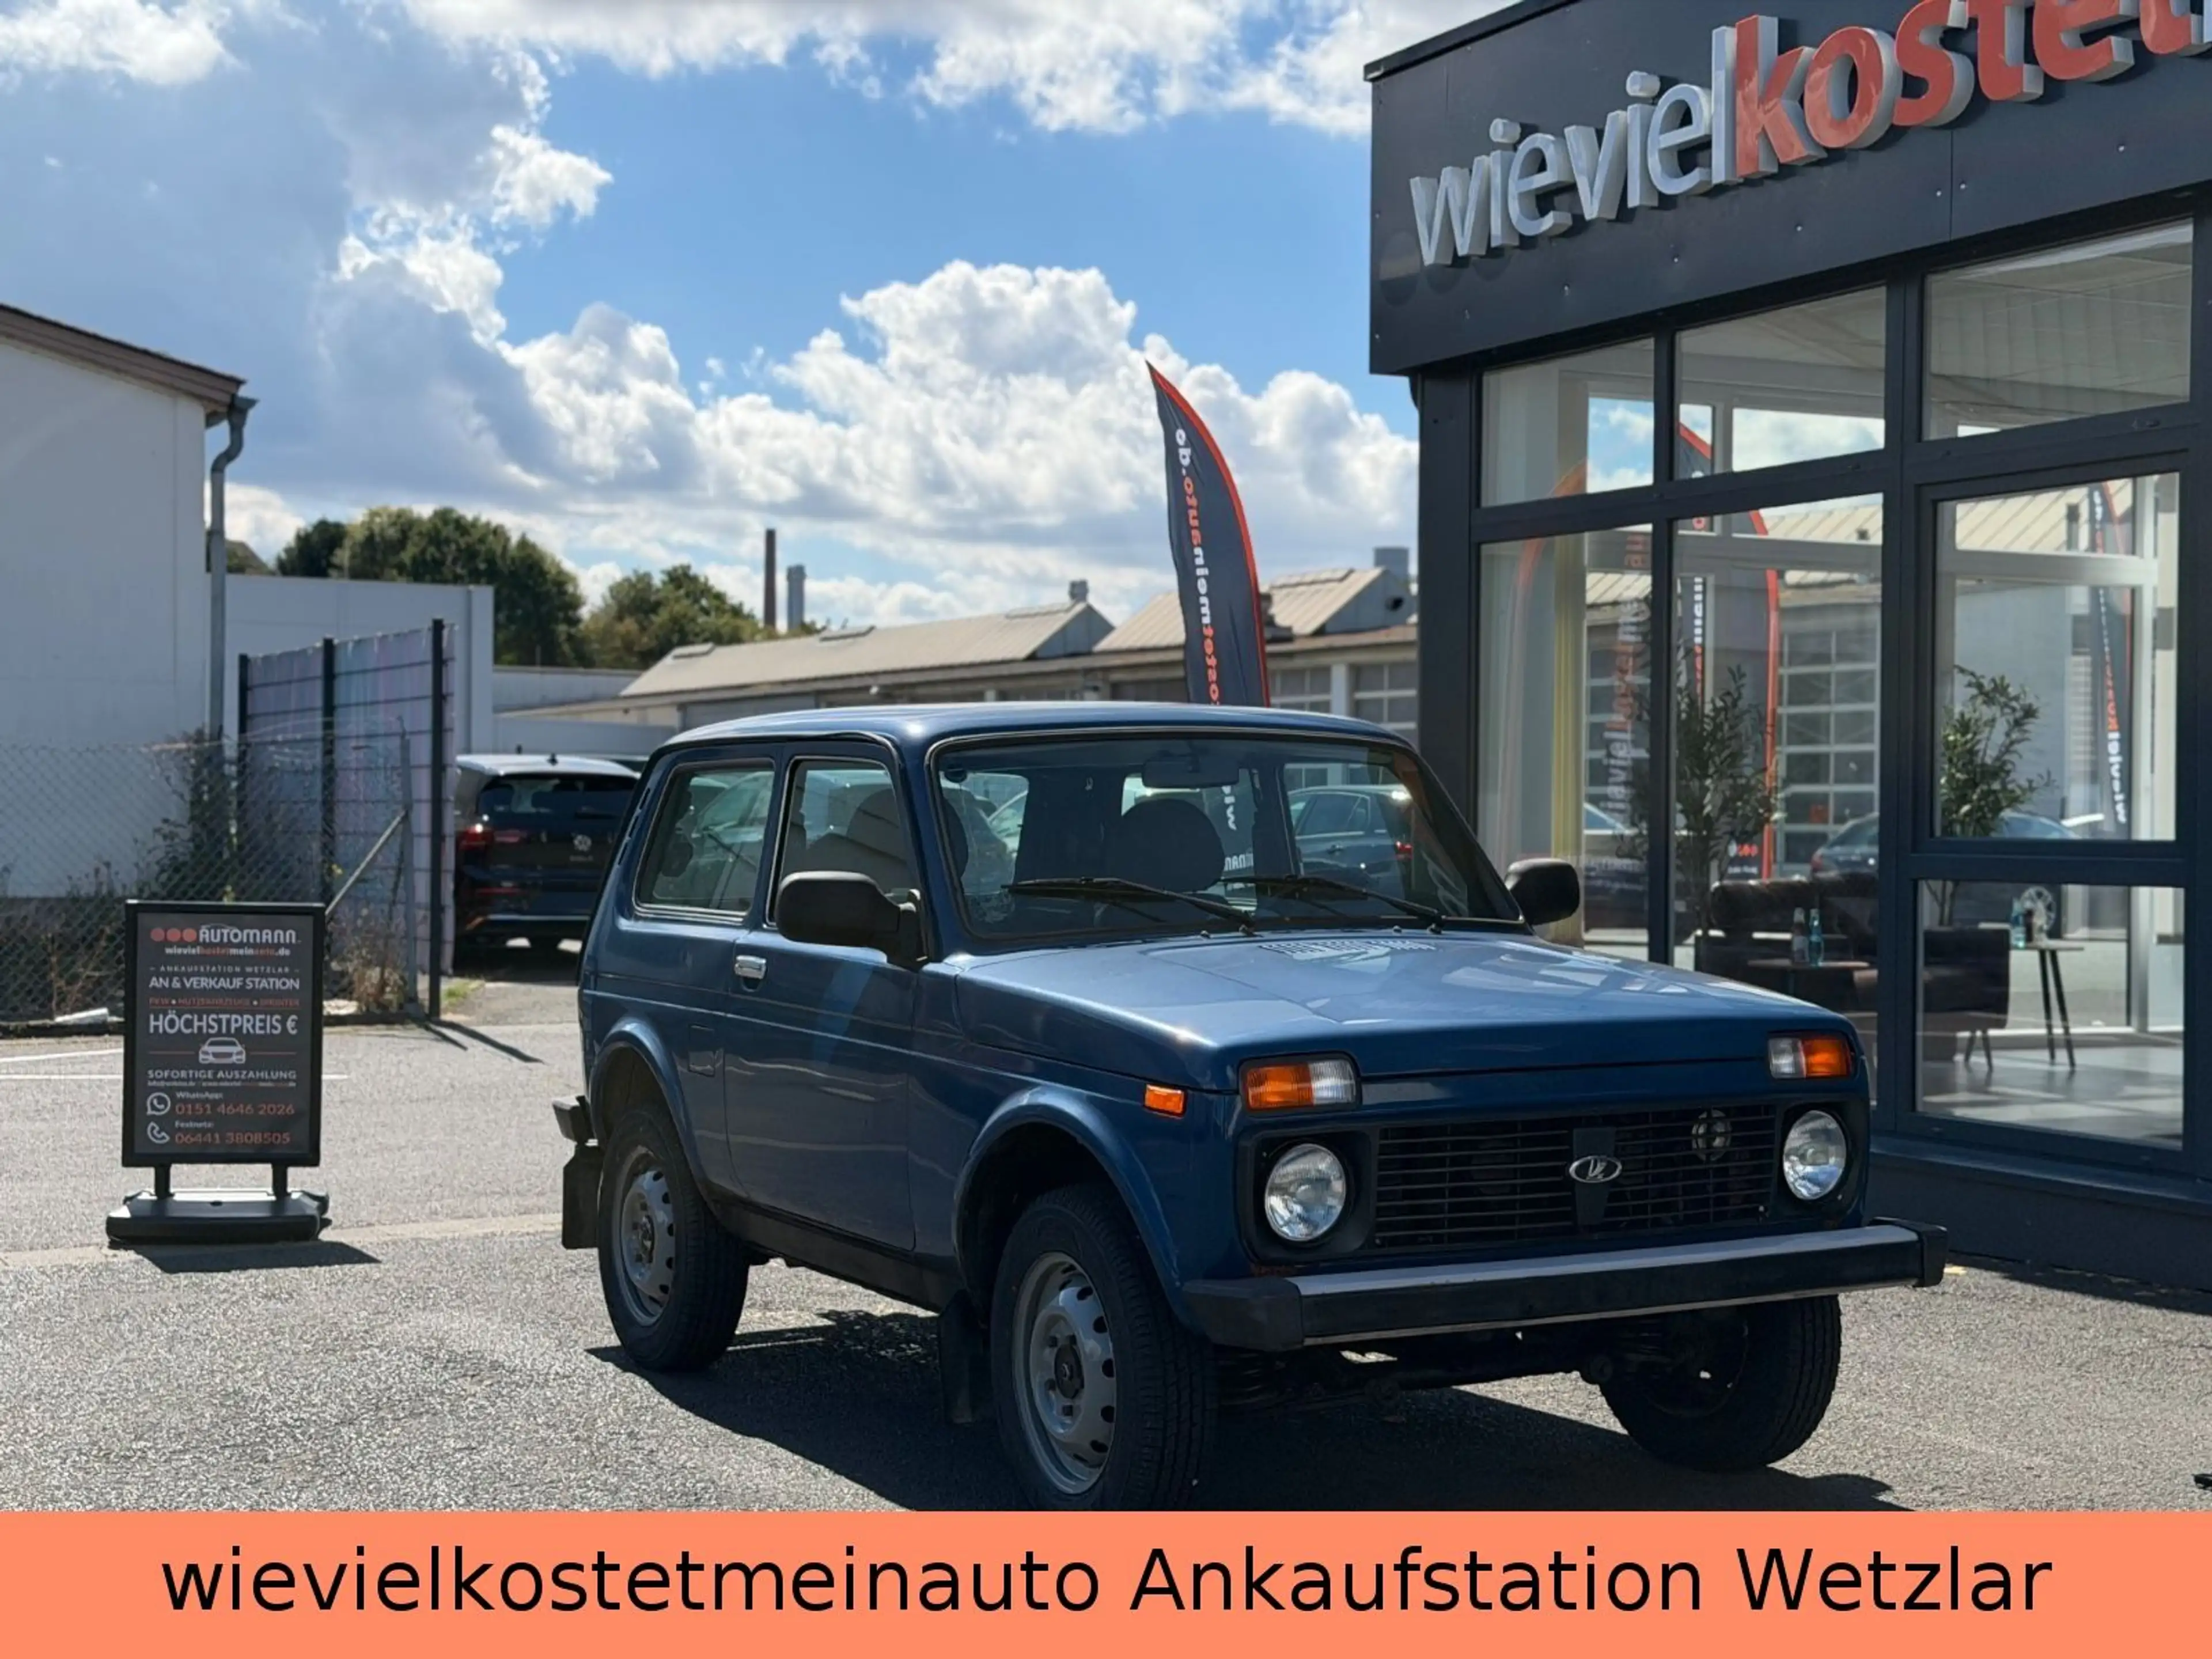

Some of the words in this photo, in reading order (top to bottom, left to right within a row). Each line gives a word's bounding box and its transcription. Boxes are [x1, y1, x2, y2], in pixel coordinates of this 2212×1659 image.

[199, 929, 297, 944] AUTOMANN
[149, 976, 169, 988] AN
[171, 976, 181, 989] &
[183, 977, 244, 989] VERKAUF
[245, 977, 300, 990] STATION
[150, 1009, 282, 1035] HÖCHSTPREIS
[286, 1014, 298, 1035] €
[147, 1070, 213, 1080] SOFORTIGE
[217, 1070, 297, 1080] AUSZAHLUNG
[175, 1103, 211, 1115] 0151
[217, 1103, 253, 1115] 4646
[258, 1103, 295, 1115] 2026
[175, 1132, 221, 1144] 06441
[225, 1132, 291, 1145] 3808505
